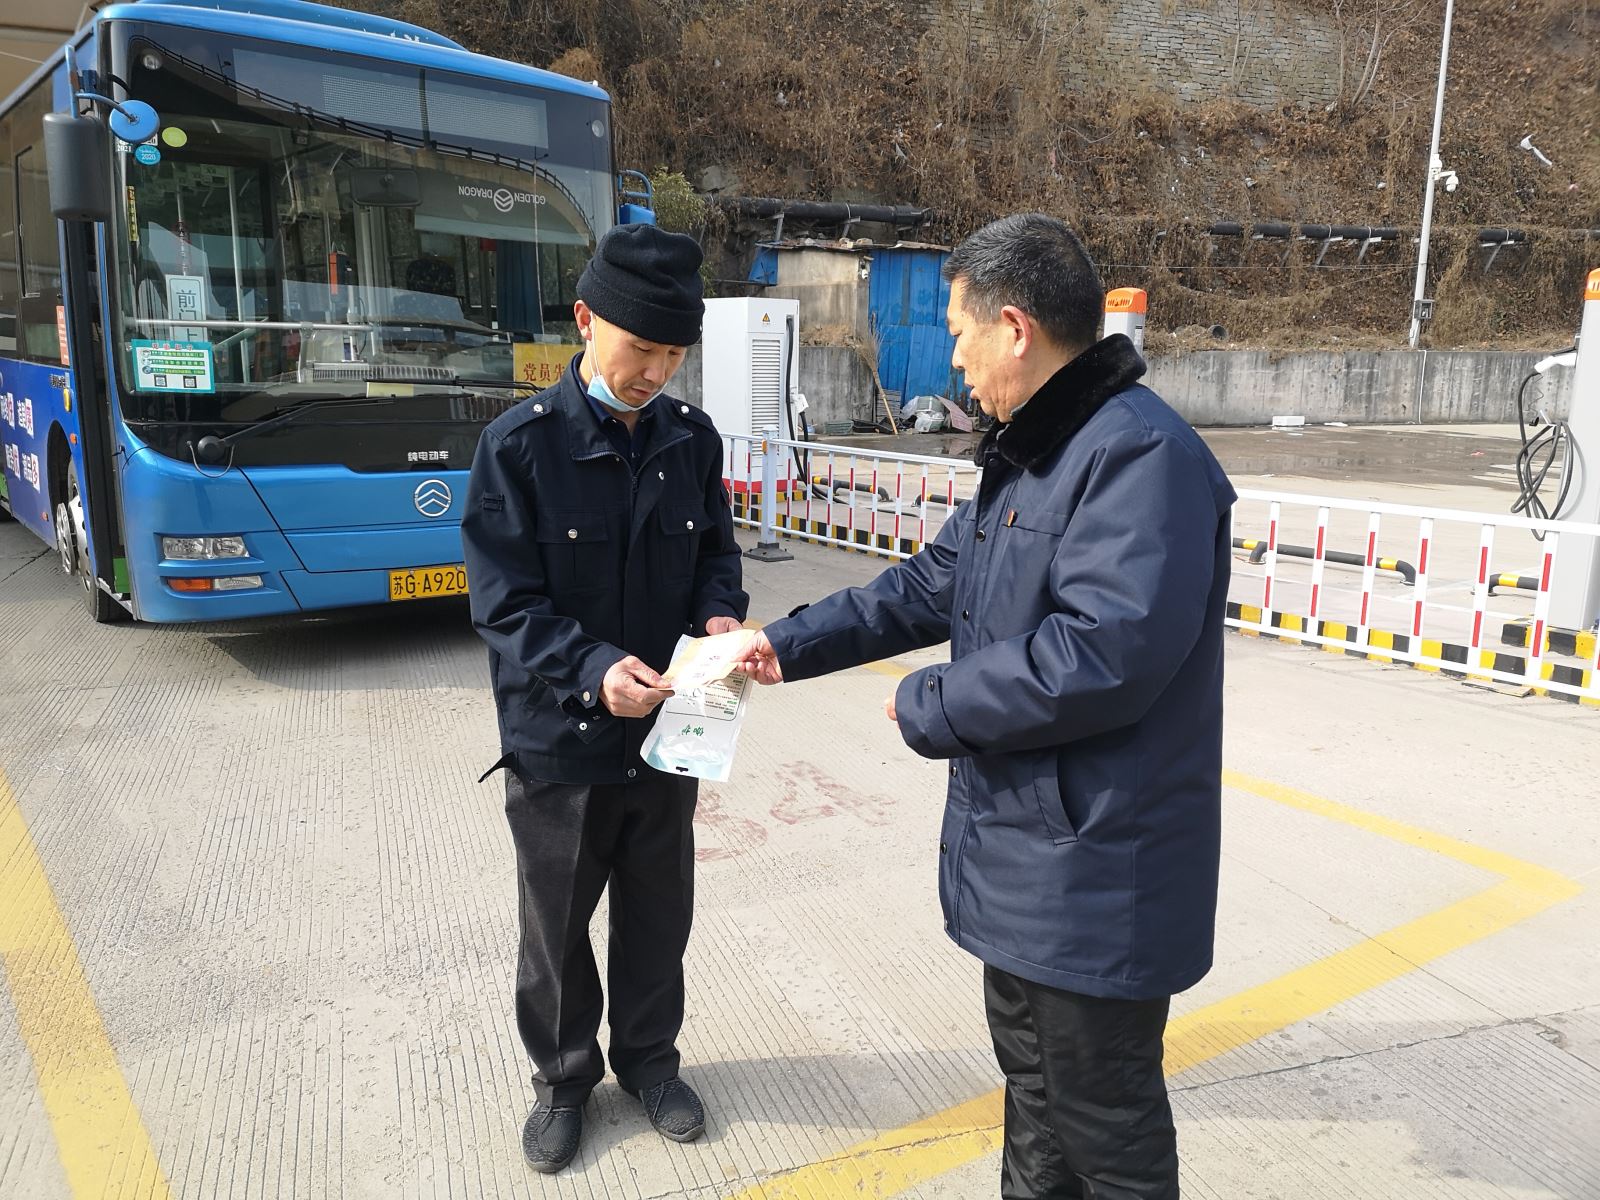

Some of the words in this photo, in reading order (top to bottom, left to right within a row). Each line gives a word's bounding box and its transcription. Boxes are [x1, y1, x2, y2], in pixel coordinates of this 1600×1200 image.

[458, 185, 493, 199] DRAGON
[514, 193, 546, 205] GOLDEN
[407, 450, 449, 462] 纯电动车
